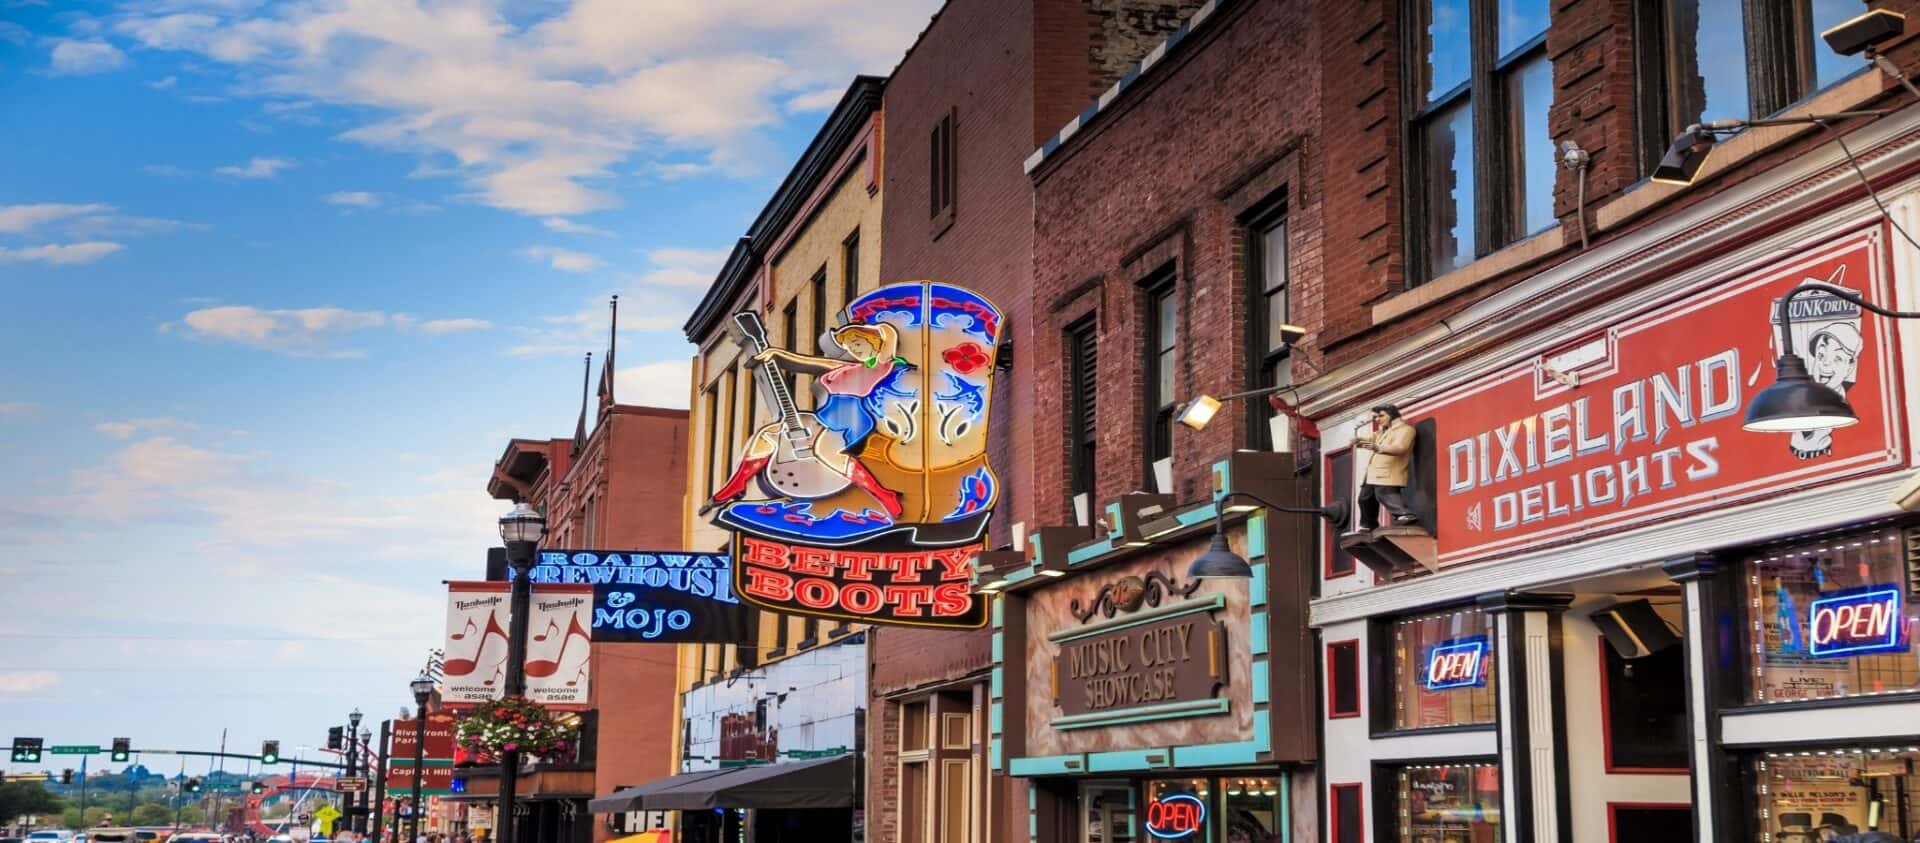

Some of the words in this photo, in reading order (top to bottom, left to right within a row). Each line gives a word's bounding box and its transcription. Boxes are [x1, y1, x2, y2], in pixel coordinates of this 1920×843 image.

[1448, 347, 1742, 496] DIXIELAND
[1493, 436, 1720, 532] DELIGHTS
[743, 538, 983, 583] BETTY
[607, 592, 636, 608] &
[746, 567, 970, 617] BOOTS
[592, 609, 692, 639] MOJO
[1815, 600, 1893, 645] OPEN
[1071, 636, 1131, 680] MUSIC
[1140, 623, 1193, 667] CITY
[1432, 650, 1479, 683] OPEN
[450, 685, 497, 694] welcome
[533, 686, 579, 695] welcome
[546, 694, 582, 702] asae
[1085, 668, 1177, 709] SHOWCASE
[395, 736, 417, 745] Park
[396, 729, 448, 737] Rivefront
[392, 768, 429, 778] Capiol
[434, 768, 452, 777] Hill
[1148, 802, 1200, 832] OPEN
